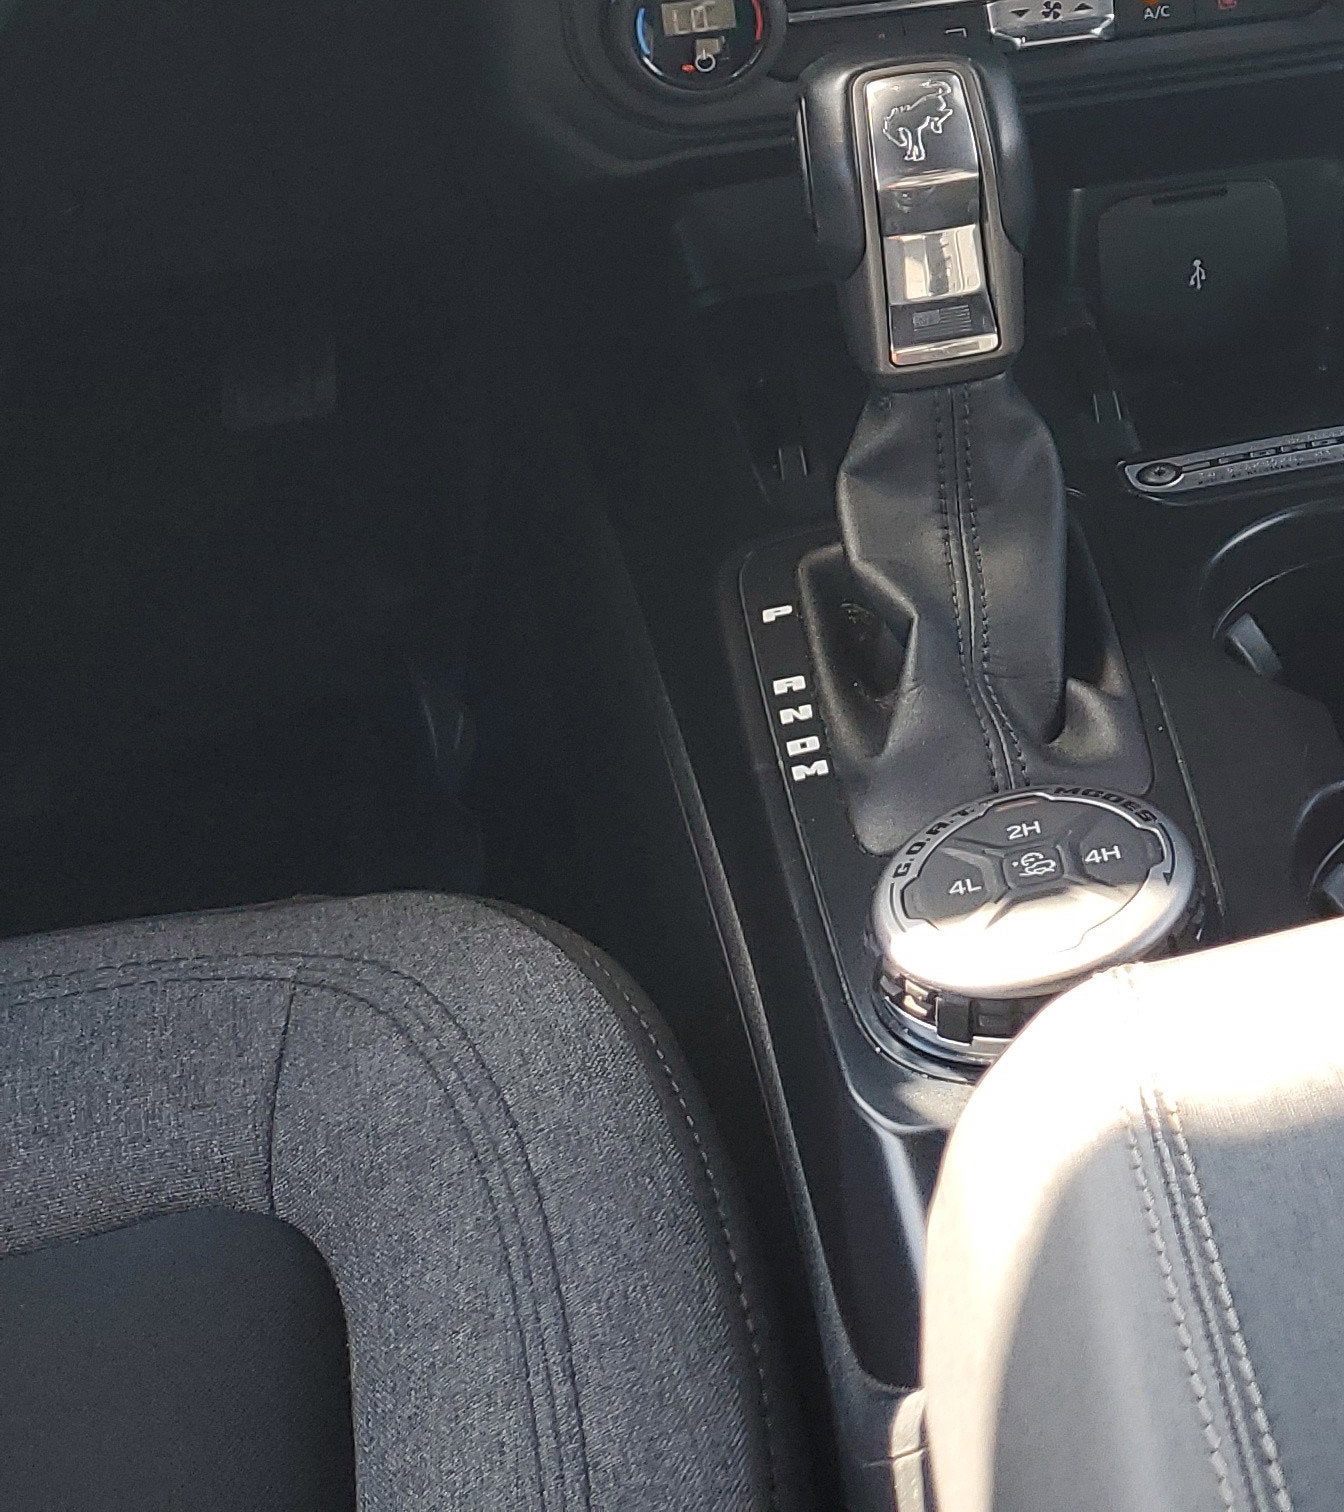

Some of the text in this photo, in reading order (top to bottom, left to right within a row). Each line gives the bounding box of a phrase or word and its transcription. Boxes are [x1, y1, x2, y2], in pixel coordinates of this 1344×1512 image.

[1143, 4, 1170, 21] A/C
[762, 605, 793, 623] P
[773, 675, 806, 695] R
[779, 704, 813, 725] N
[791, 759, 829, 781] M
[1054, 786, 1158, 823] MODES
[1006, 820, 1042, 840] 2H
[1085, 845, 1122, 864] 4H
[949, 878, 982, 896] 4L
